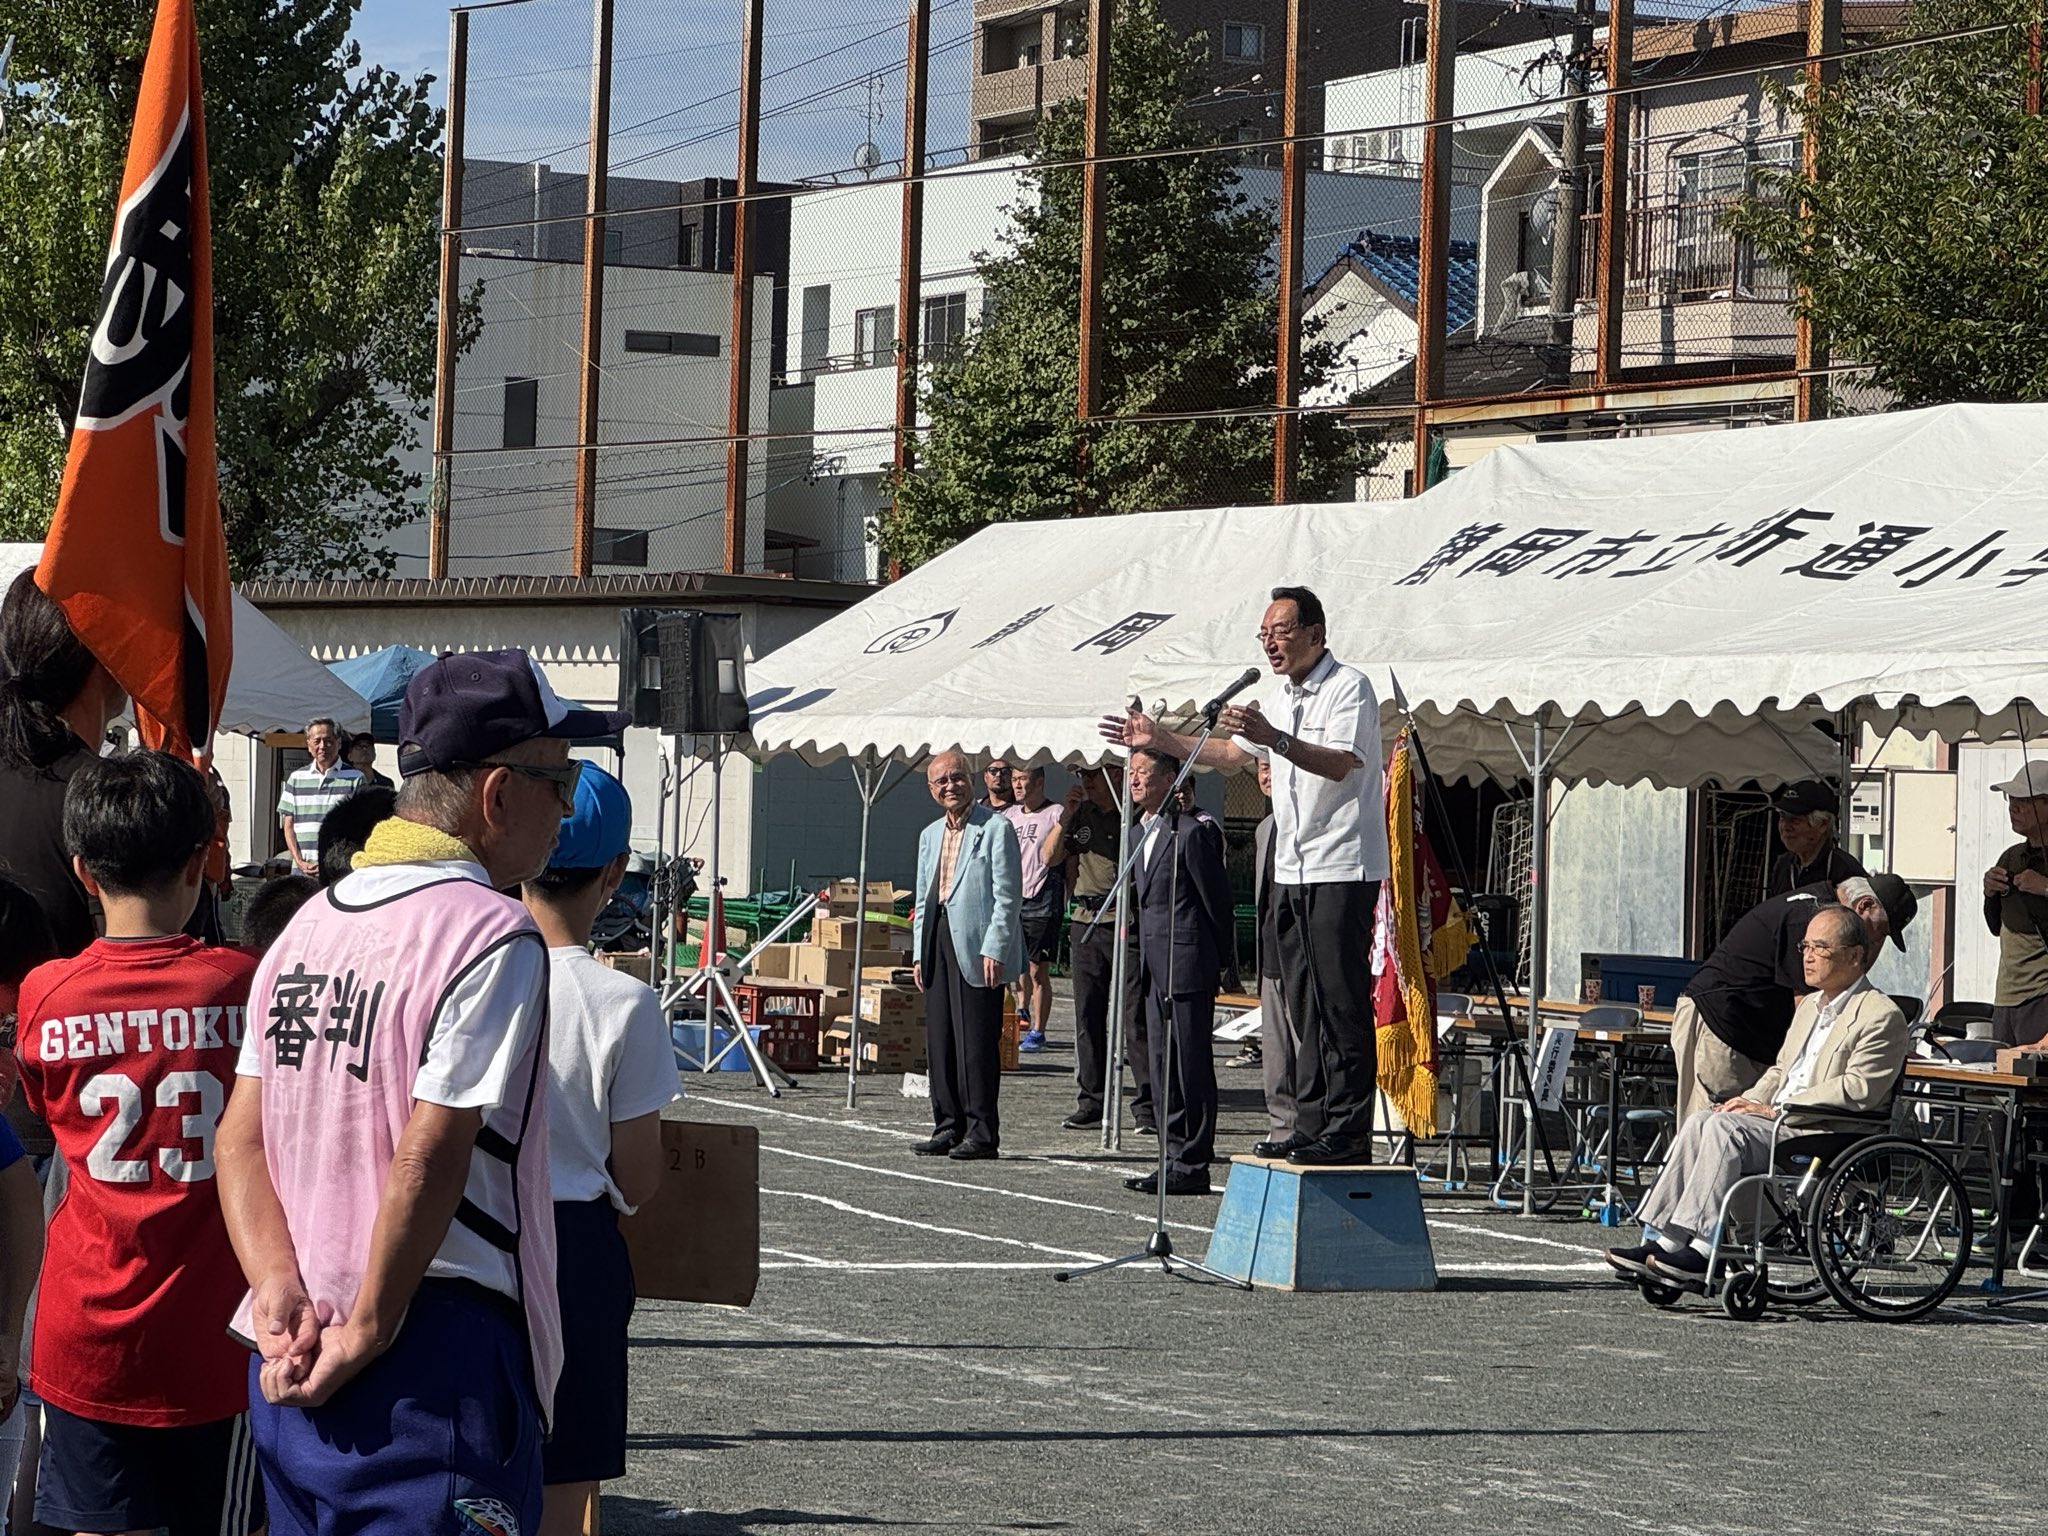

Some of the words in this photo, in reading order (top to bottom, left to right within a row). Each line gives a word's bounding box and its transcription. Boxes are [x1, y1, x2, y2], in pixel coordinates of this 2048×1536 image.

[39, 1005, 247, 1062] GENTOKU
[265, 962, 386, 1083] 審判
[79, 1070, 225, 1183] 23
[669, 1148, 681, 1171] 2
